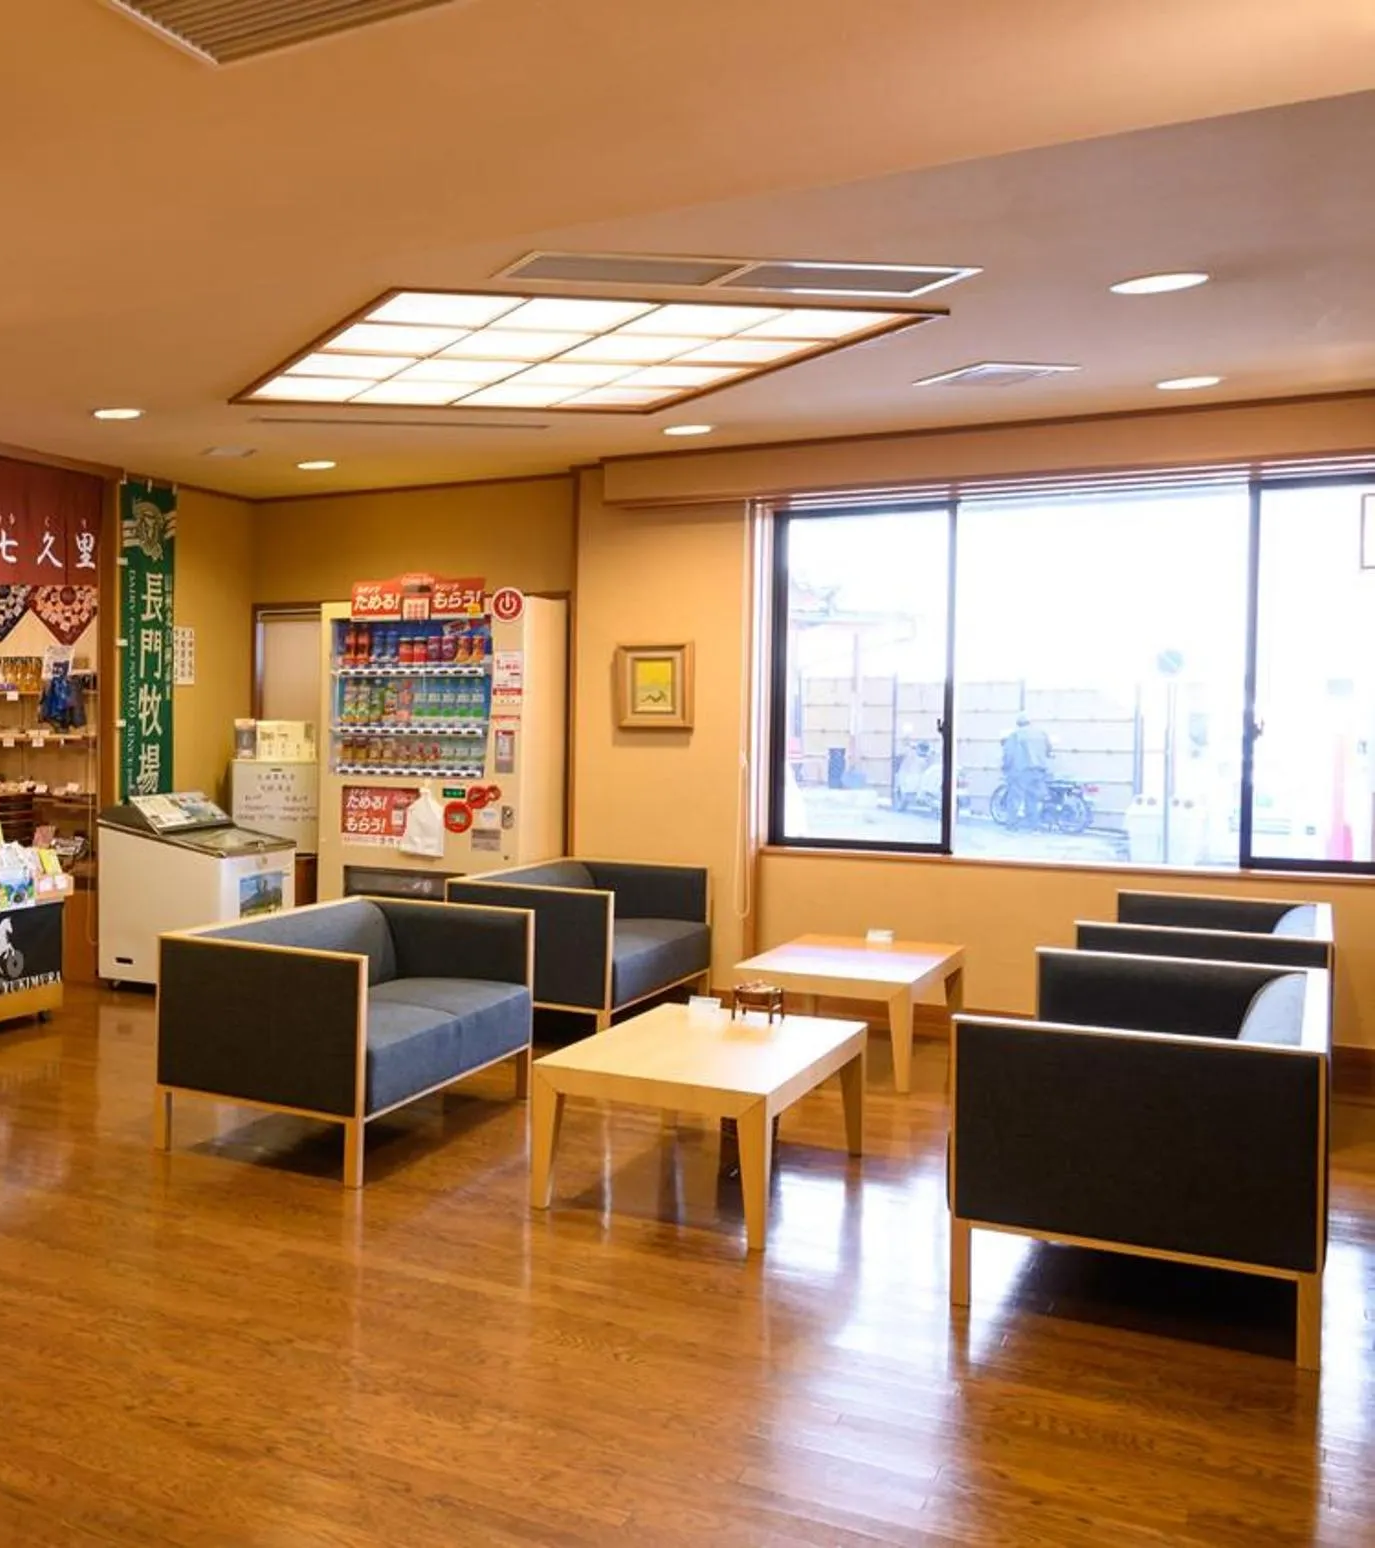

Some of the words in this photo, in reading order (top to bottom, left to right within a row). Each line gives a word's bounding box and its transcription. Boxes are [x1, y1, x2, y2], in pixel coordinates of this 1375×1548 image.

[137, 573, 163, 795] 長門牧場
[2, 970, 62, 994] YUKIMURA
